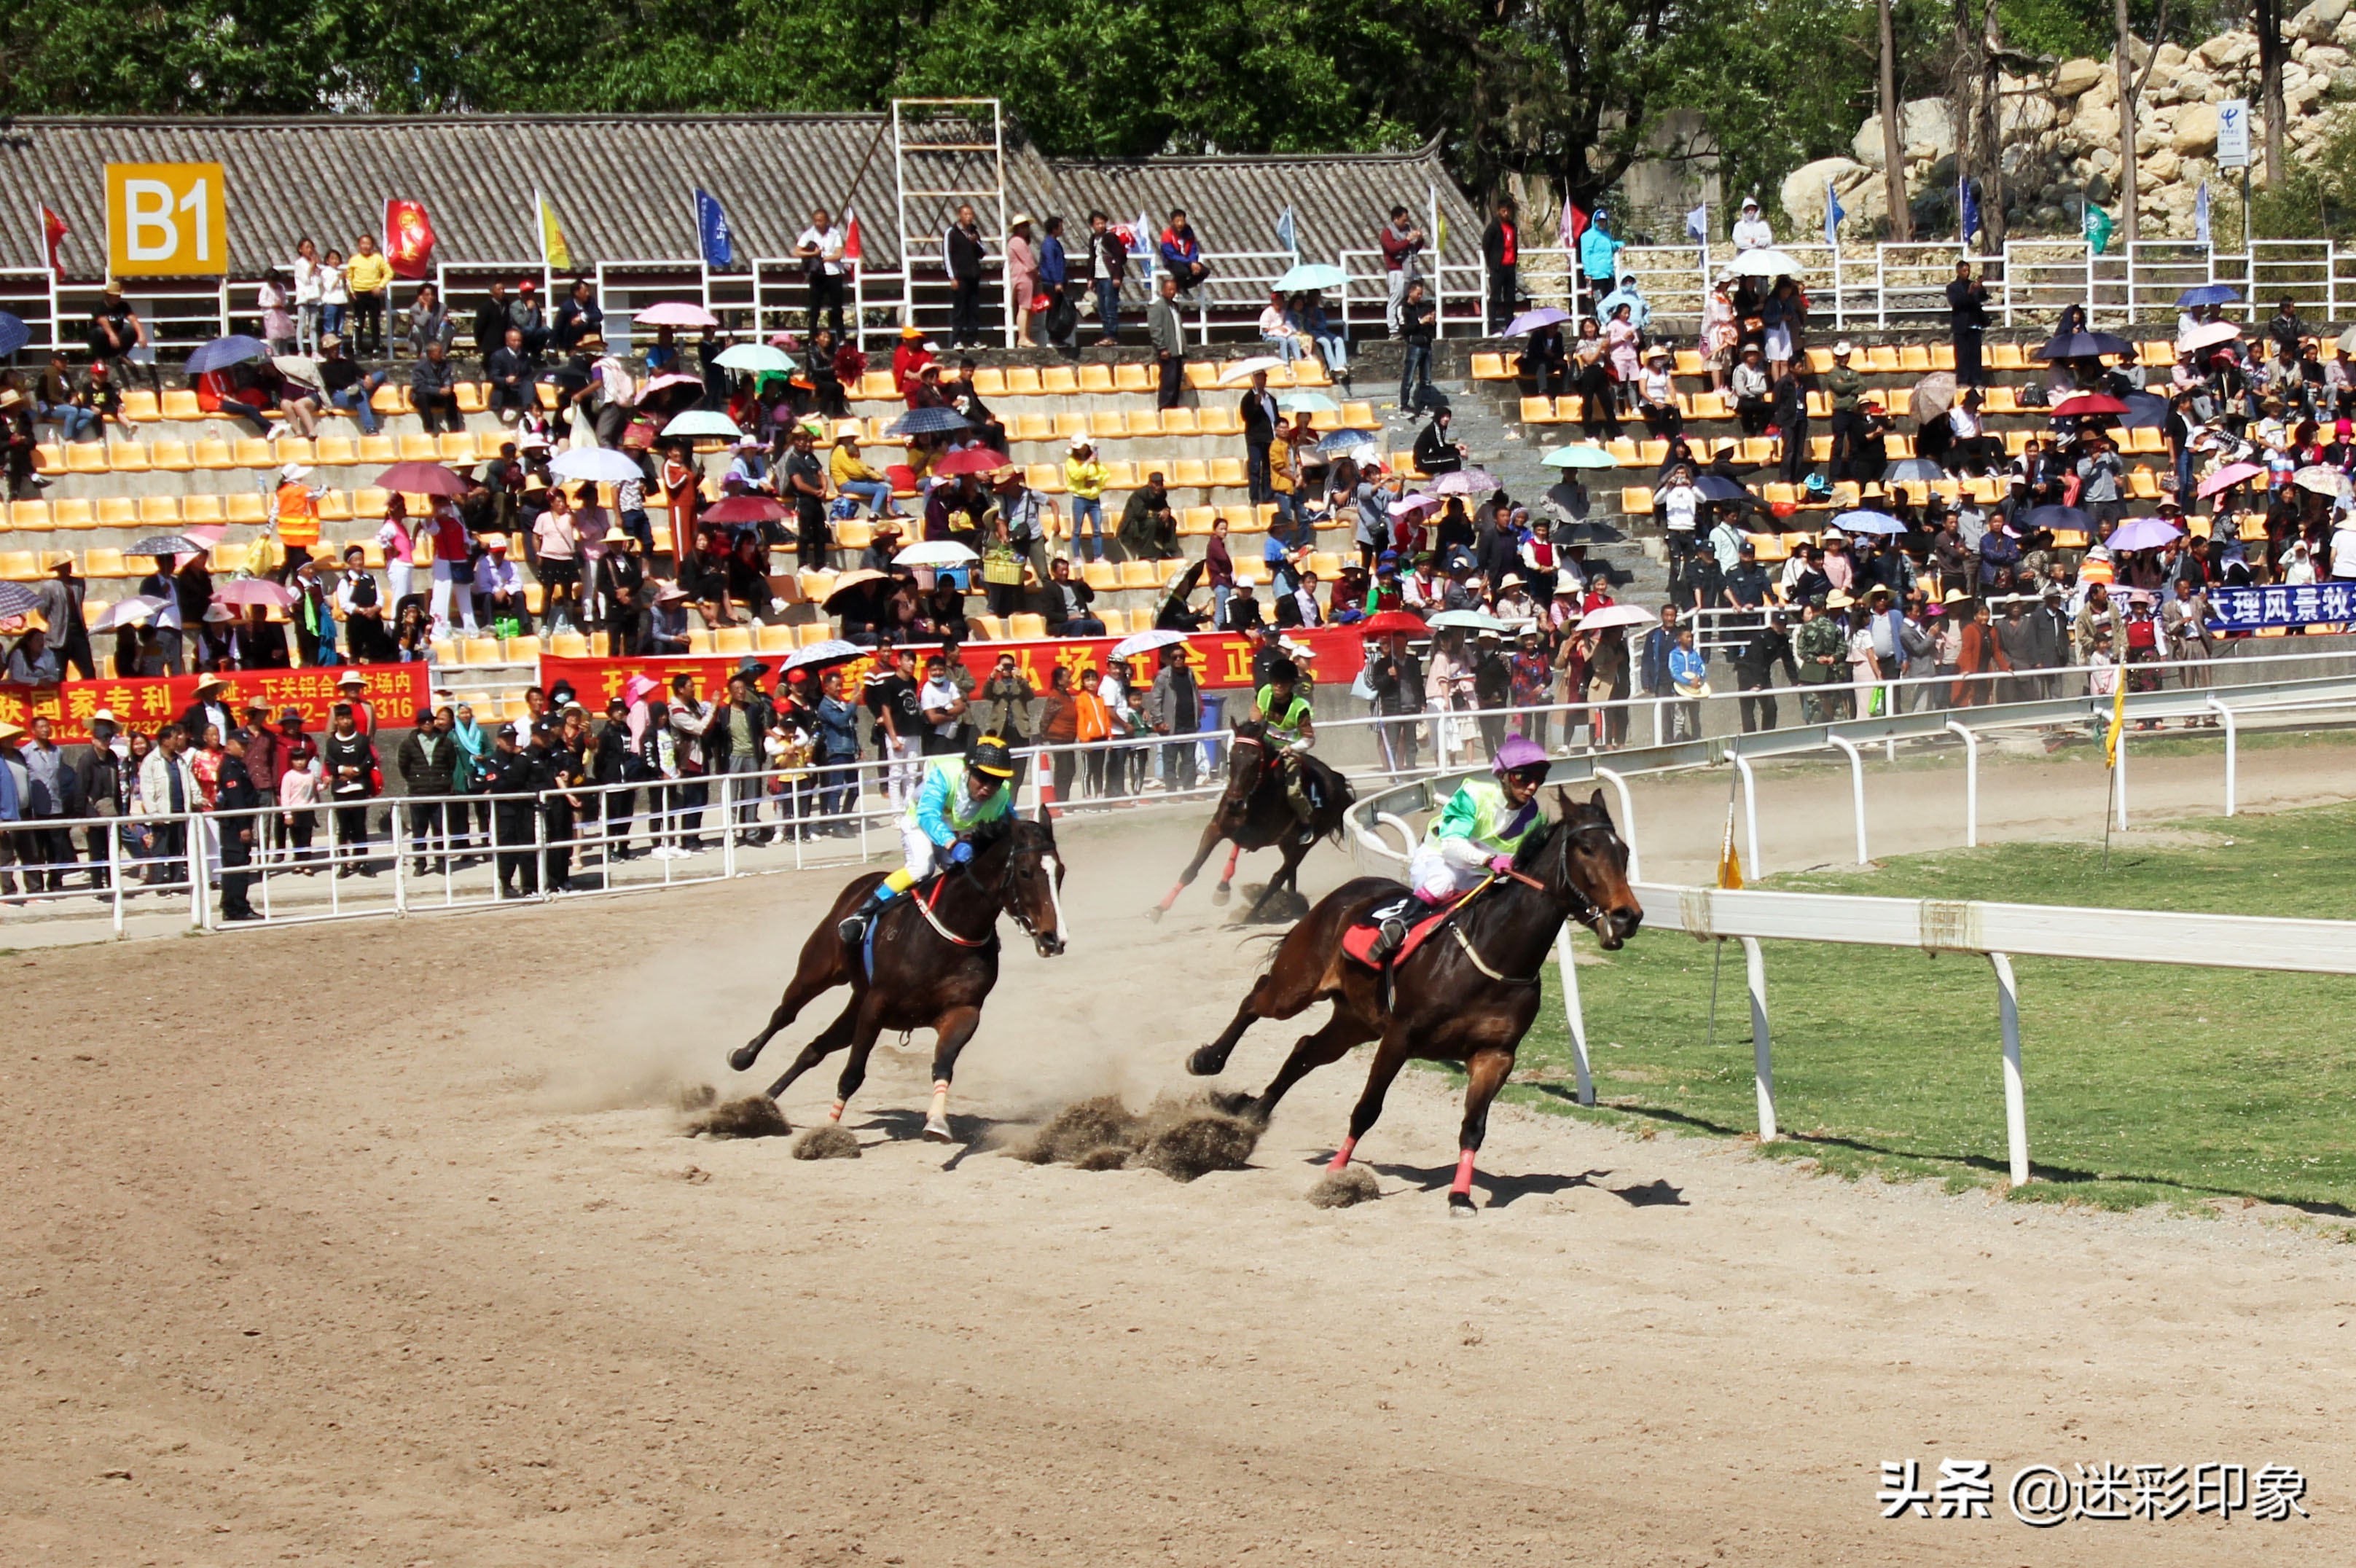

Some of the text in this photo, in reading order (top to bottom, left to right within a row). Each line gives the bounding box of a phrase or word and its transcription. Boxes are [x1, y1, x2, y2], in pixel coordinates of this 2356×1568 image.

[125, 179, 209, 261] B1
[2204, 586, 2356, 624] 大理风景牧
[998, 639, 1318, 691] 弘扬会正
